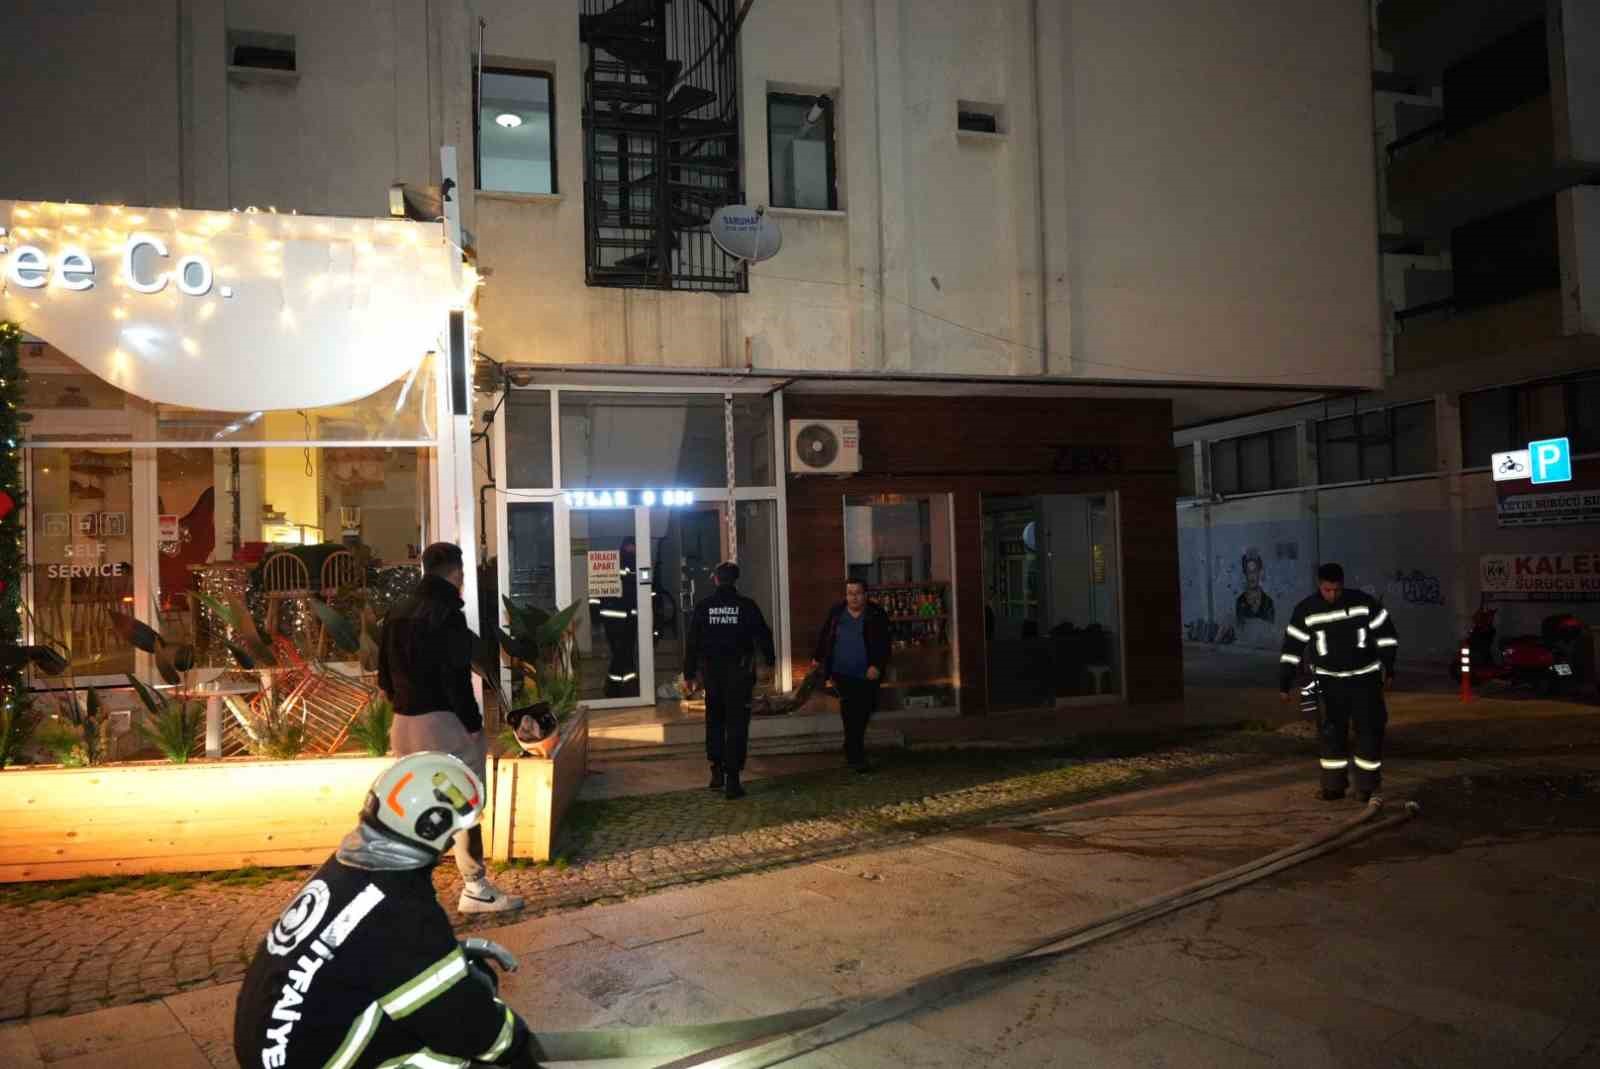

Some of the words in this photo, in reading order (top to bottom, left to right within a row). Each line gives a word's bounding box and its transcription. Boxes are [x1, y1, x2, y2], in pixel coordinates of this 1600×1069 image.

[0, 228, 95, 291] ee
[126, 232, 232, 298] Co.
[1537, 444, 1561, 480] P
[63, 544, 106, 558] SELF
[47, 563, 122, 578] SERVICE
